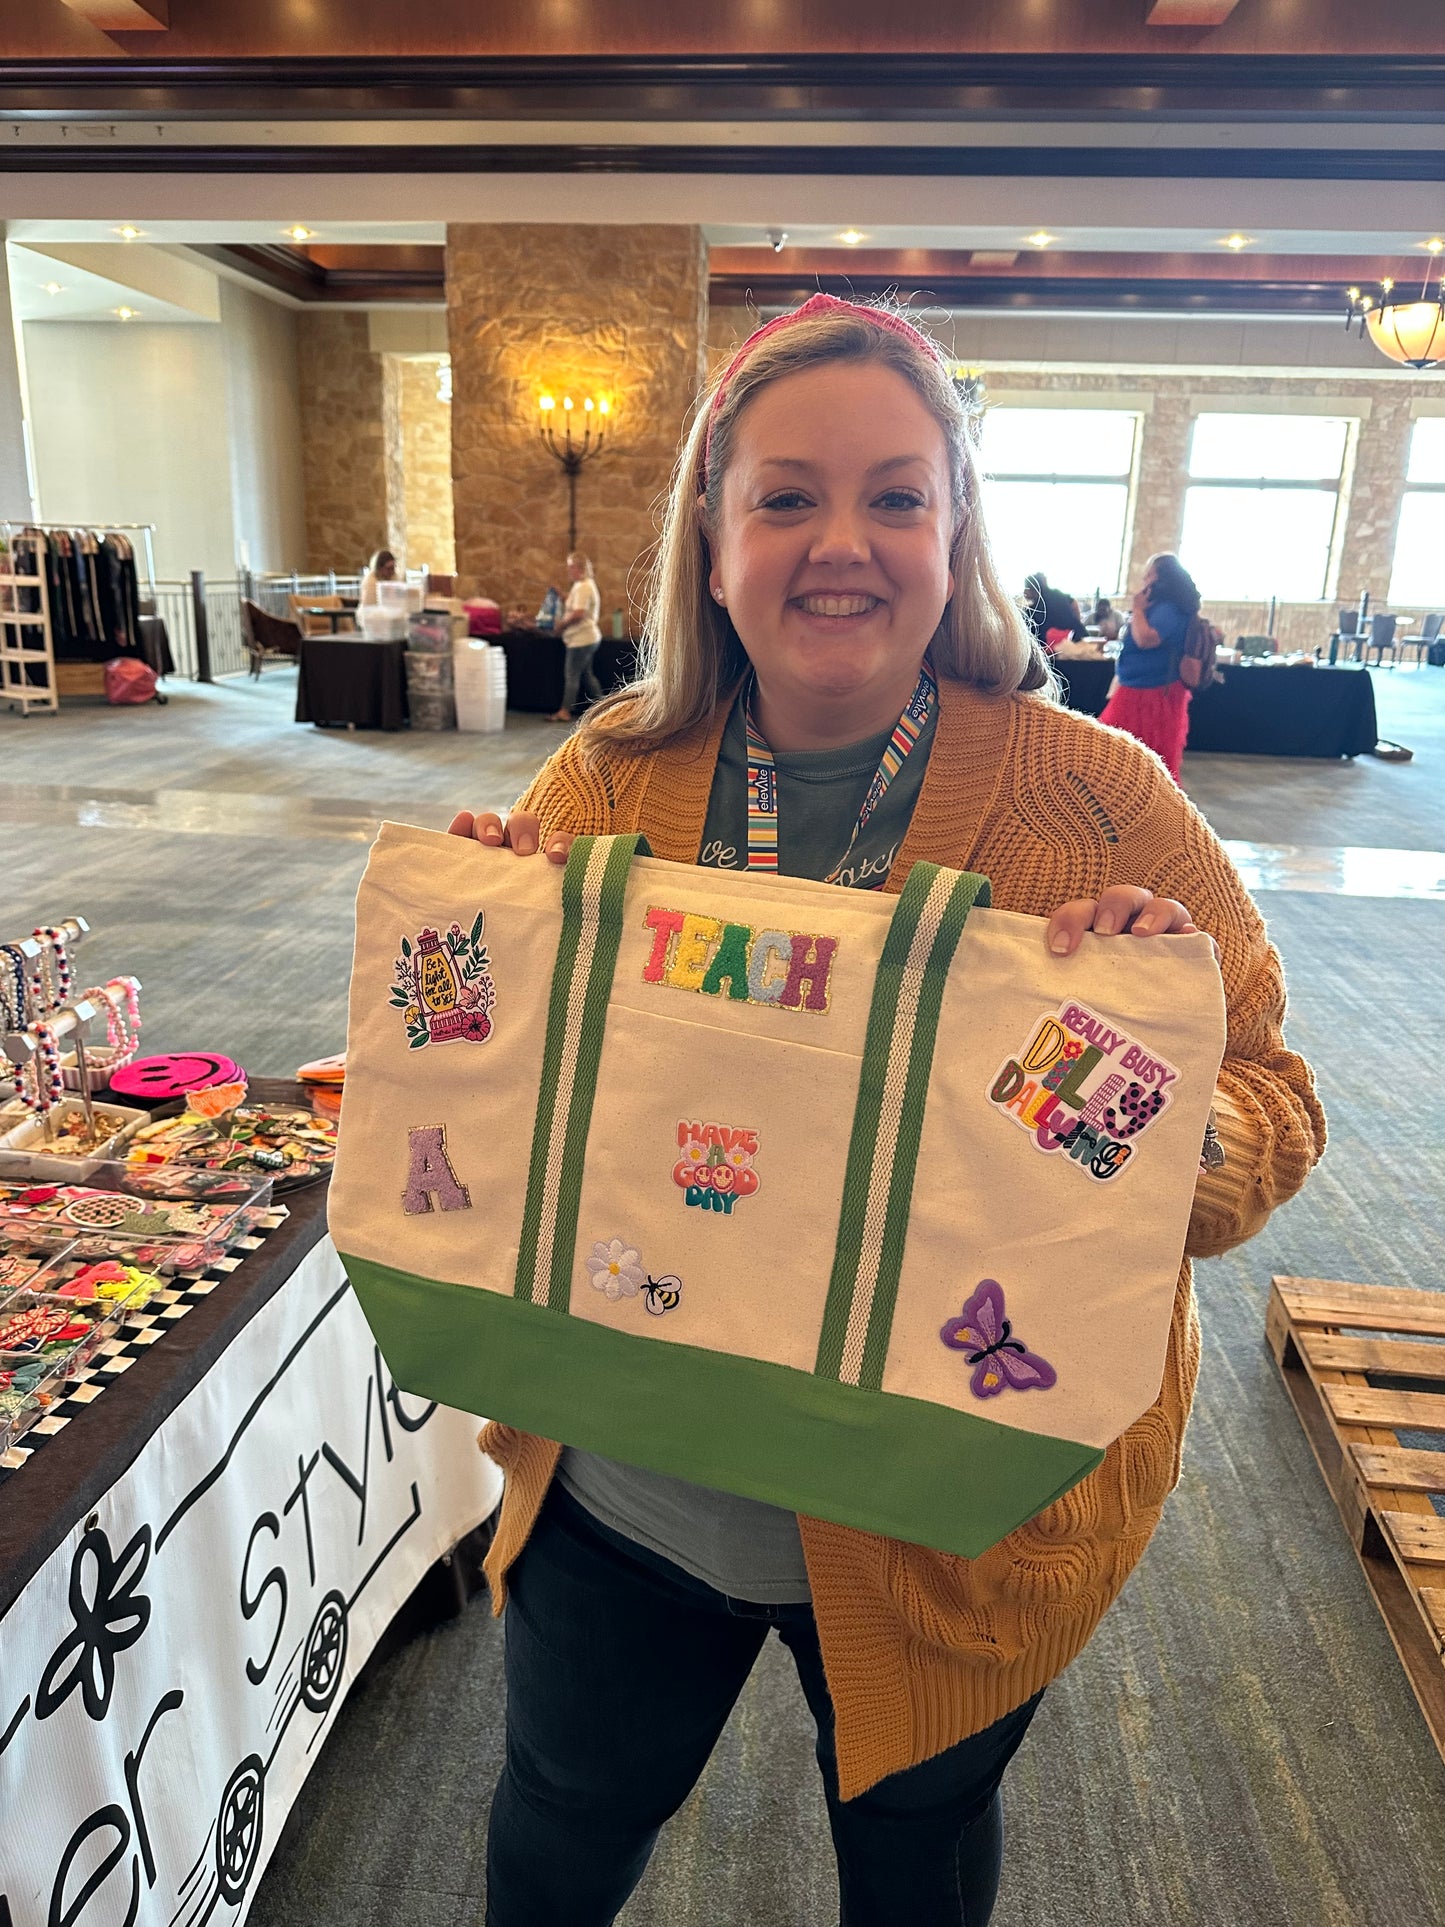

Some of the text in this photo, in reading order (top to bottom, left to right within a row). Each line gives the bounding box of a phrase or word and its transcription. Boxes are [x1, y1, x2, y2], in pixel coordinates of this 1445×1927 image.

[643, 906, 838, 1014] TEACH
[1060, 1005, 1176, 1089] REALLY BUSY
[401, 1123, 473, 1216] A
[677, 1121, 758, 1155] HAVE
[685, 1184, 740, 1215] DAY
